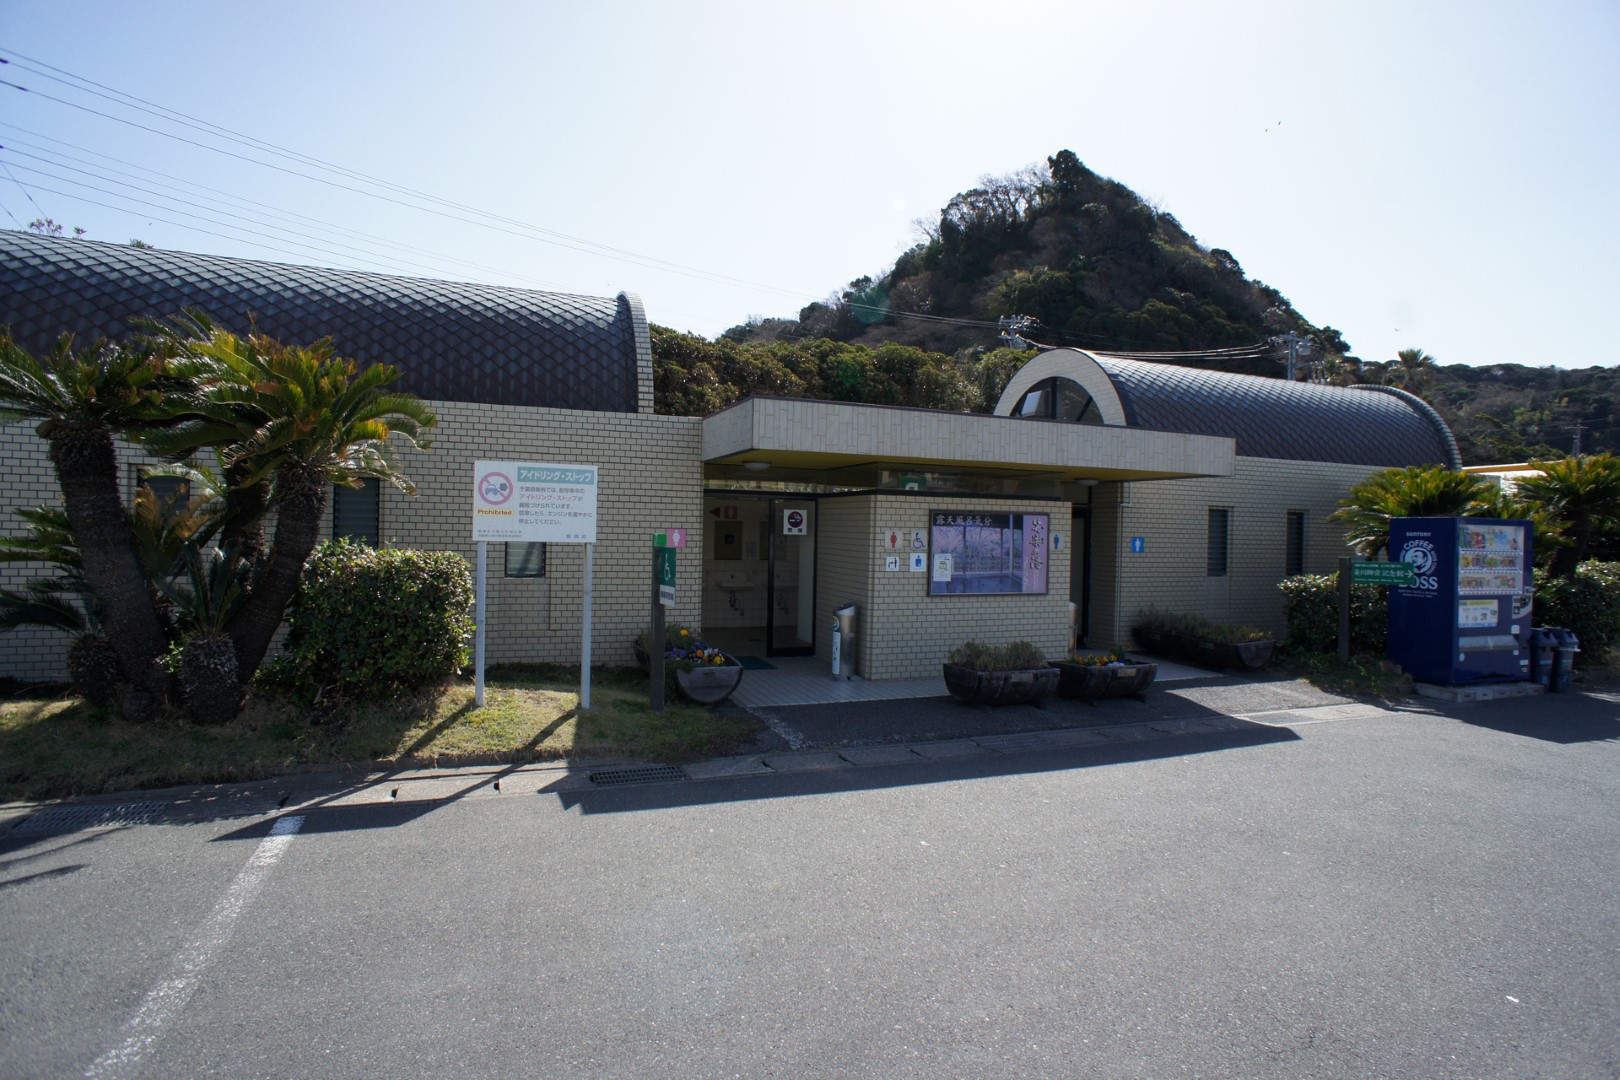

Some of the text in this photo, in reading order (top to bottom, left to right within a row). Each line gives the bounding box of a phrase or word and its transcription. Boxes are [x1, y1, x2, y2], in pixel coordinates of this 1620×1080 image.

[520, 470, 592, 482] アイドリング・ストップ
[1404, 540, 1434, 551] COFFEE
[1398, 575, 1438, 590] OSS
